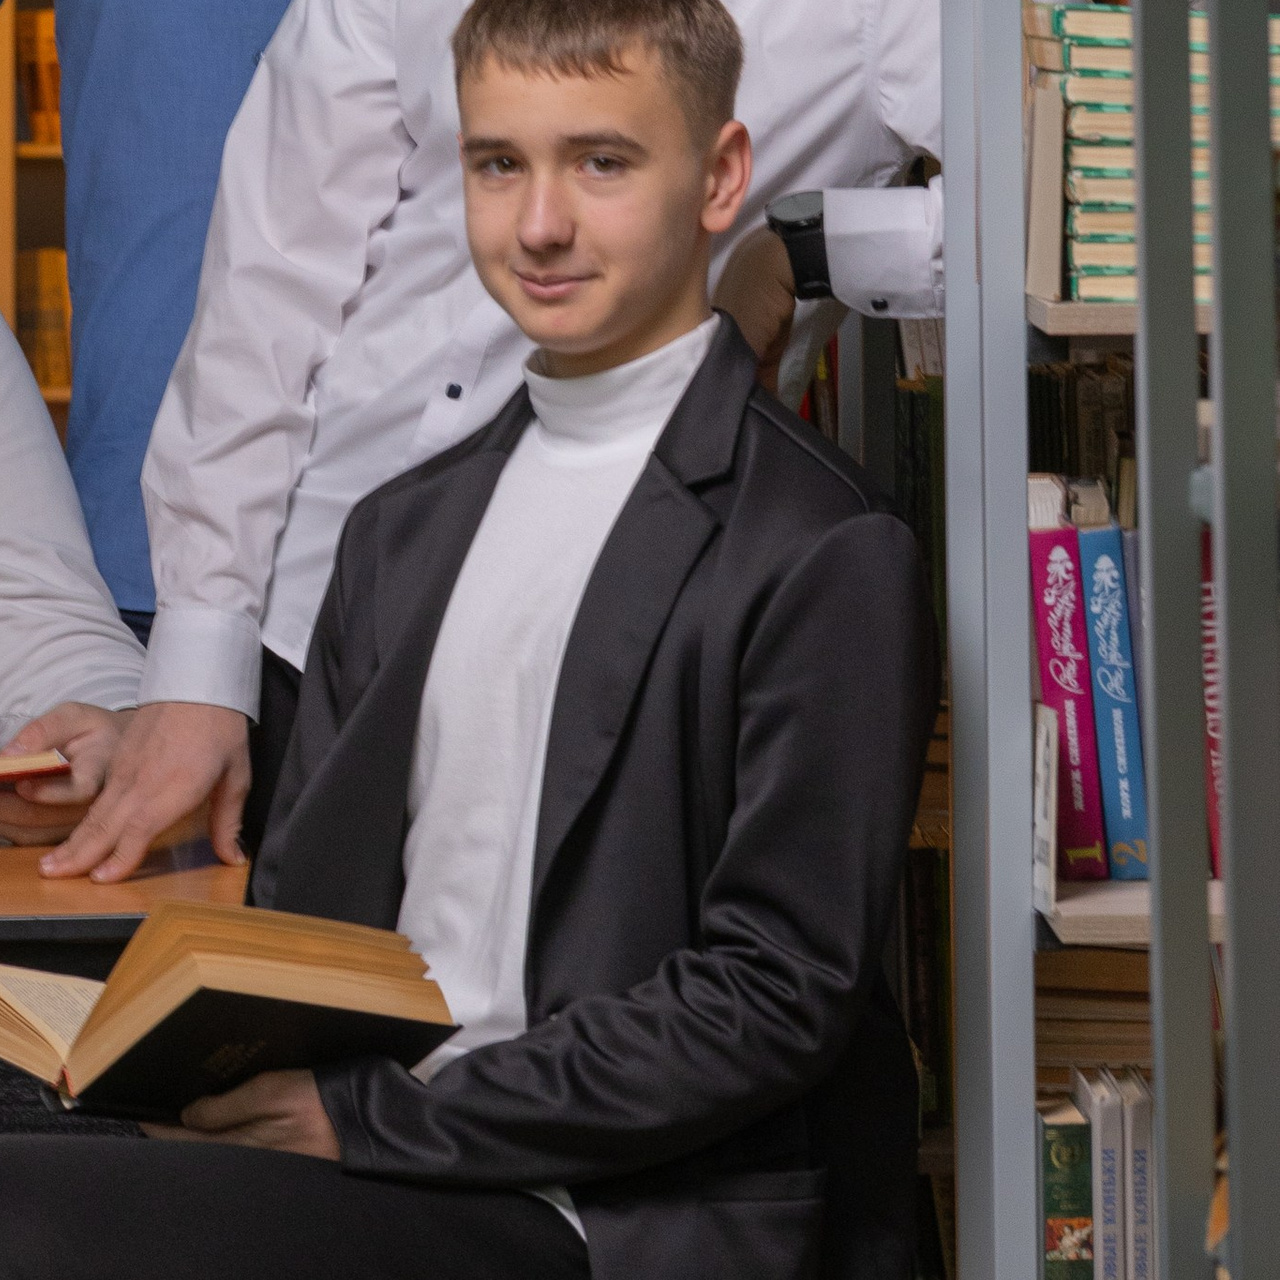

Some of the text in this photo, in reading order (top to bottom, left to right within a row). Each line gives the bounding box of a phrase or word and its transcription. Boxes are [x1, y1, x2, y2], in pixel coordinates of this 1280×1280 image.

[1067, 841, 1103, 866] 1
[1113, 838, 1149, 866] 2
[1101, 1148, 1117, 1225] КОНЬКИ
[1132, 1148, 1148, 1225] КОНЬКИ
